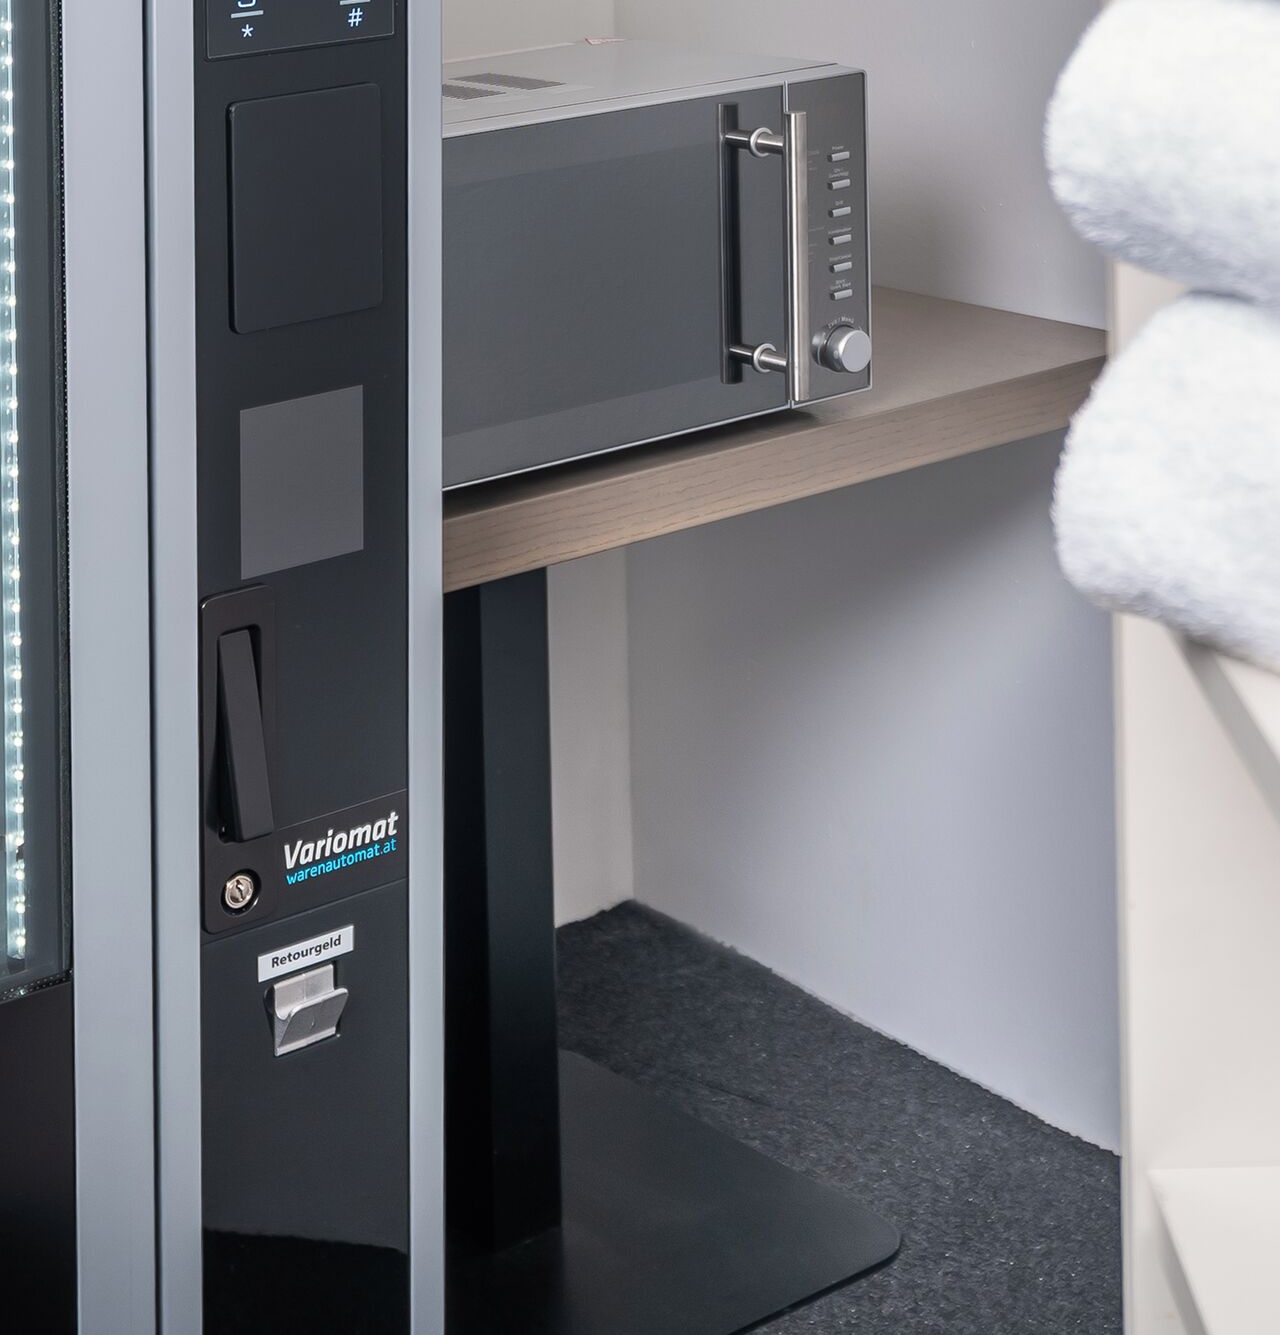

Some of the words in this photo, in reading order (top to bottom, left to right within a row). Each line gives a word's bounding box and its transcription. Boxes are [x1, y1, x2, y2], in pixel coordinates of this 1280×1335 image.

[284, 811, 399, 870] Variomat
[286, 839, 397, 885] warenautomat.at
[271, 934, 342, 969] Retourgeld
